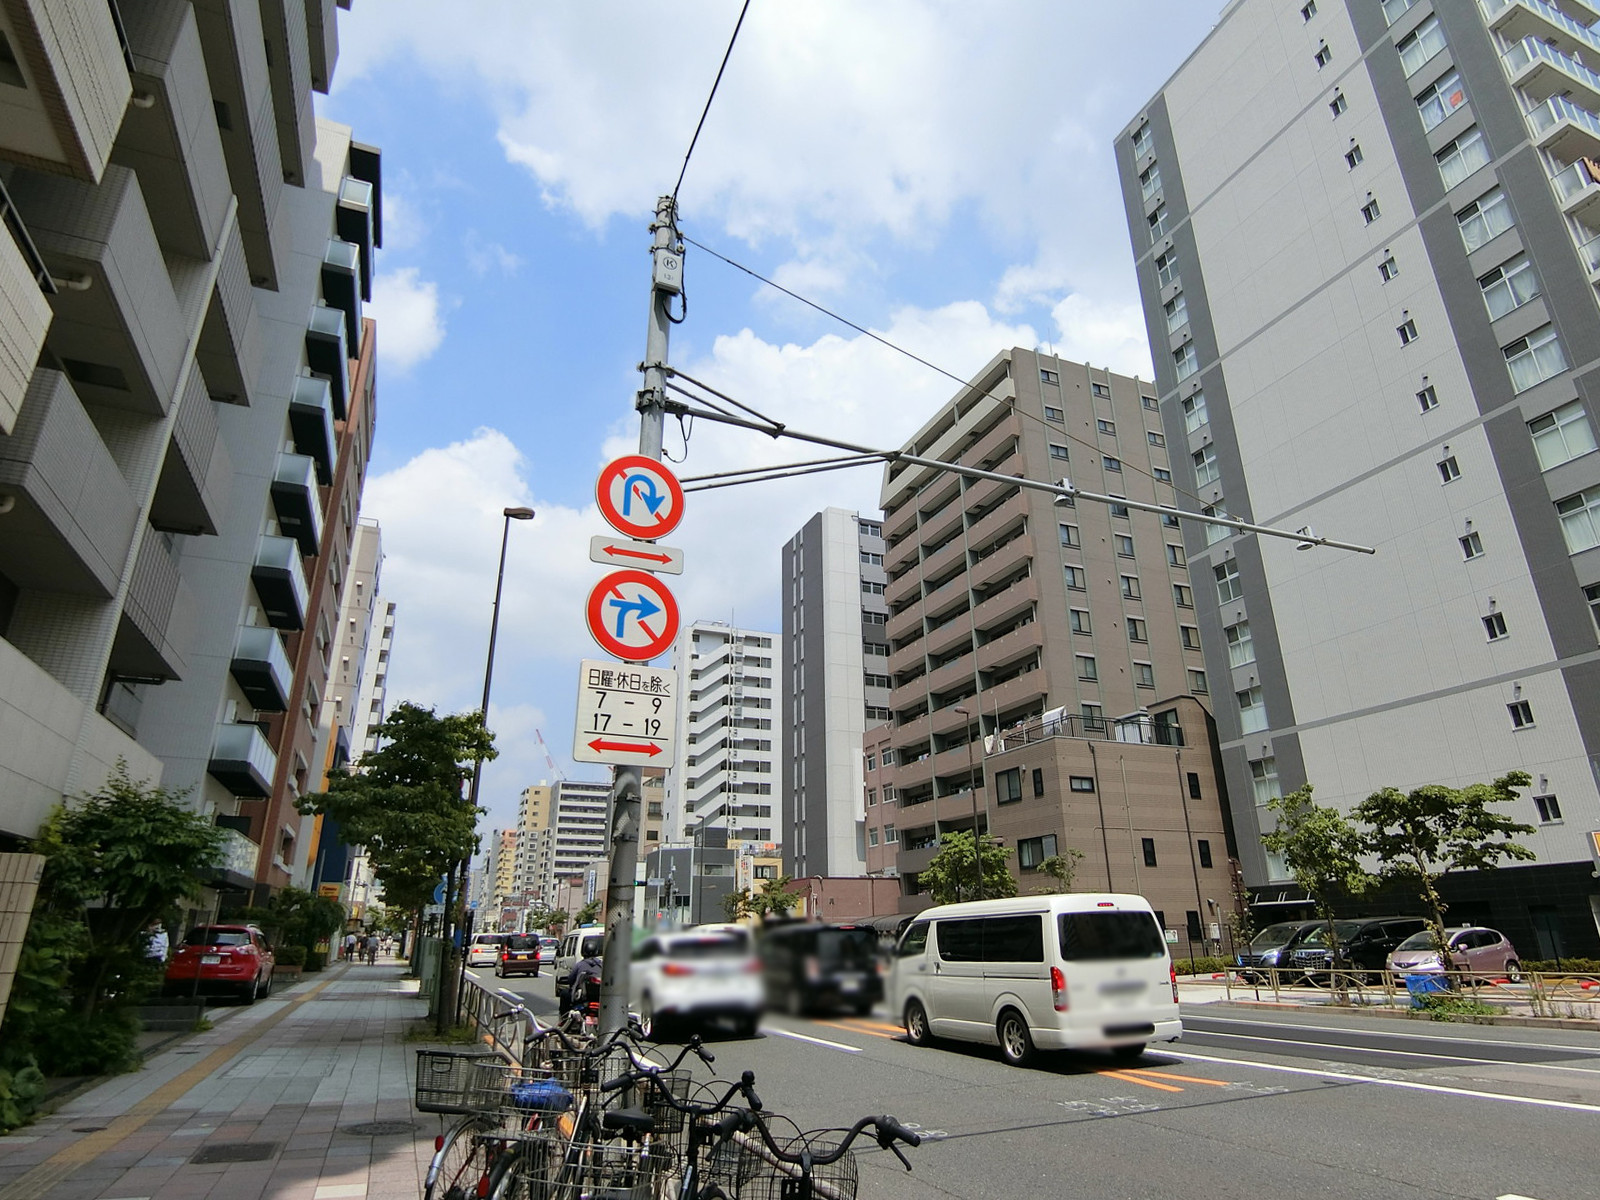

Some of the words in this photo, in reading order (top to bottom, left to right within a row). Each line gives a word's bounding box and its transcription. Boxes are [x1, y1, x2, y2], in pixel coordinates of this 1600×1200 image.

[596, 691, 607, 709] 7
[652, 697, 662, 715] 9
[593, 713, 612, 731] 17
[644, 718, 661, 736] 19
